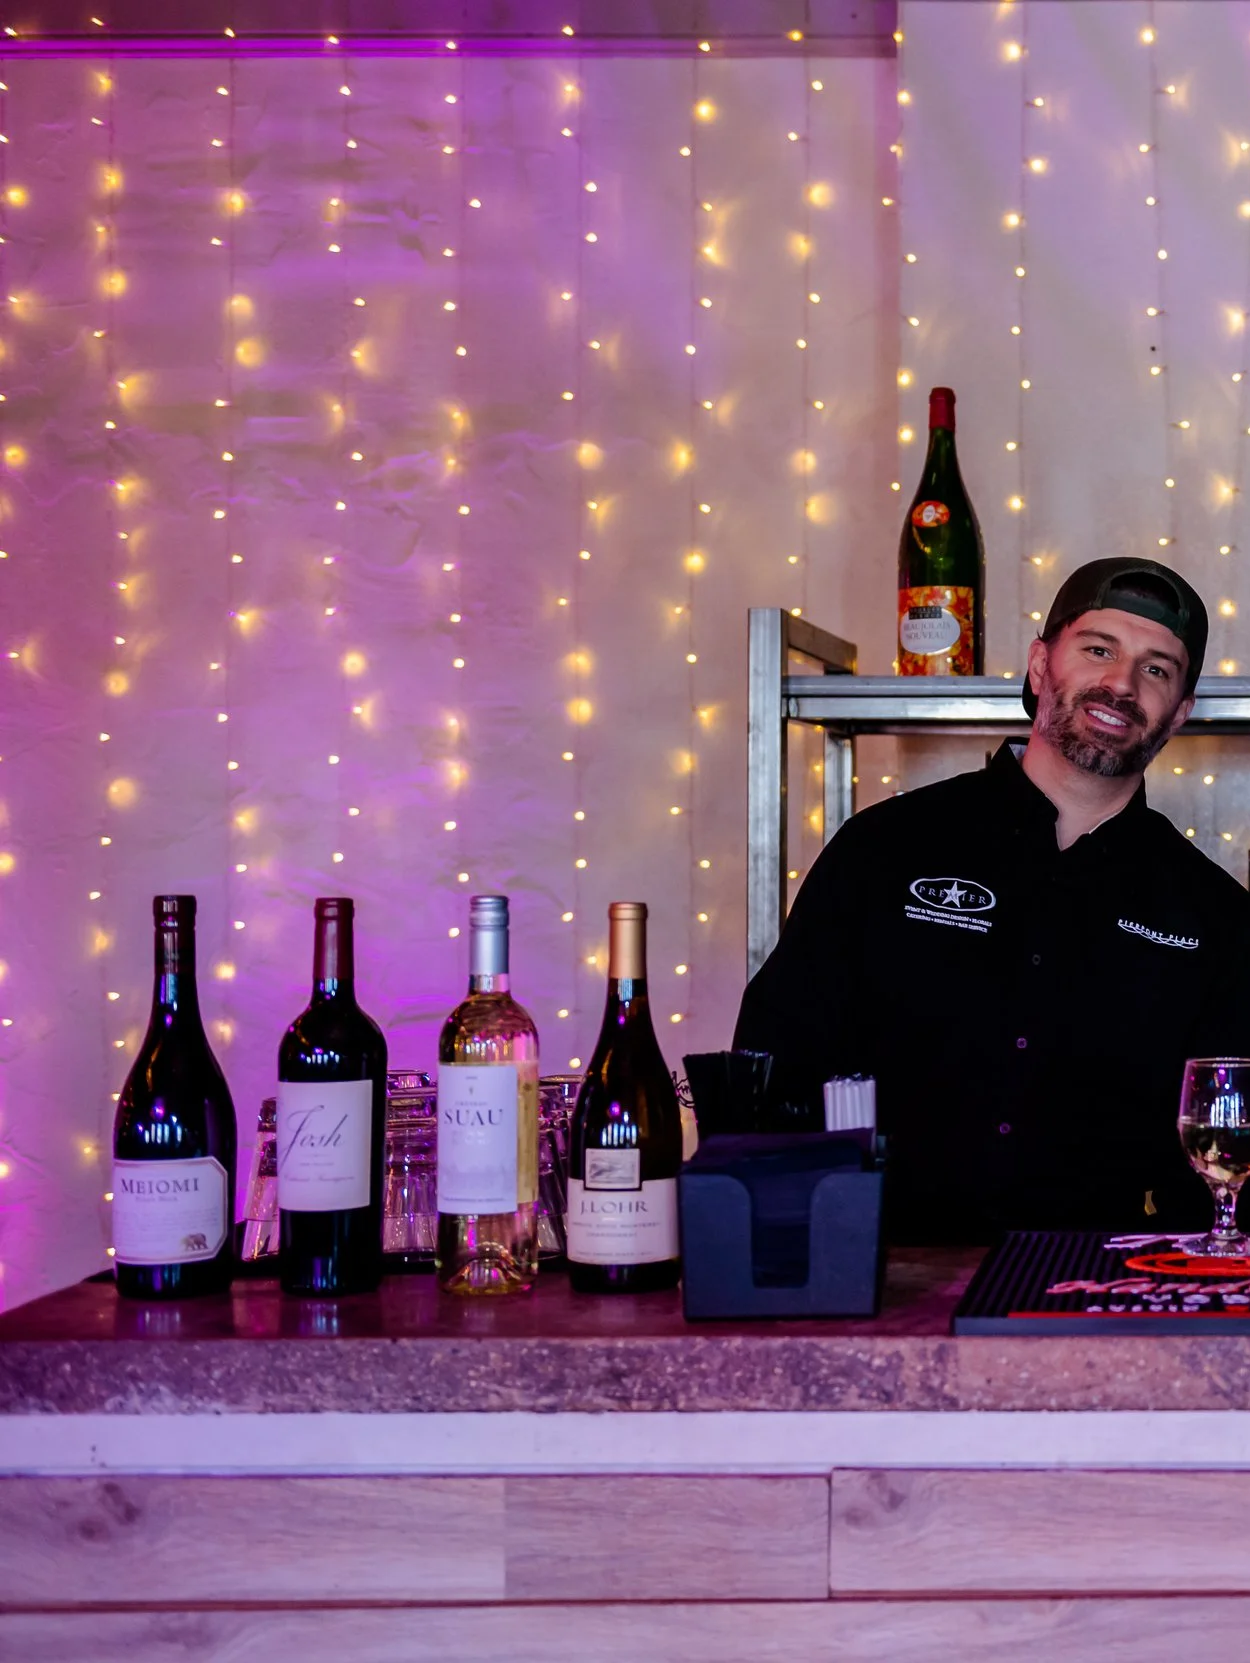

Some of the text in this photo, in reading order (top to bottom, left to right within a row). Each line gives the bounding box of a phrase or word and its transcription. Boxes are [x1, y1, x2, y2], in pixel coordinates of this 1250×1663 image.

[919, 885, 987, 905] PREMIER
[444, 1109, 503, 1126] SUAU
[280, 1104, 348, 1171] Josh
[120, 1177, 199, 1195] MEIOMI
